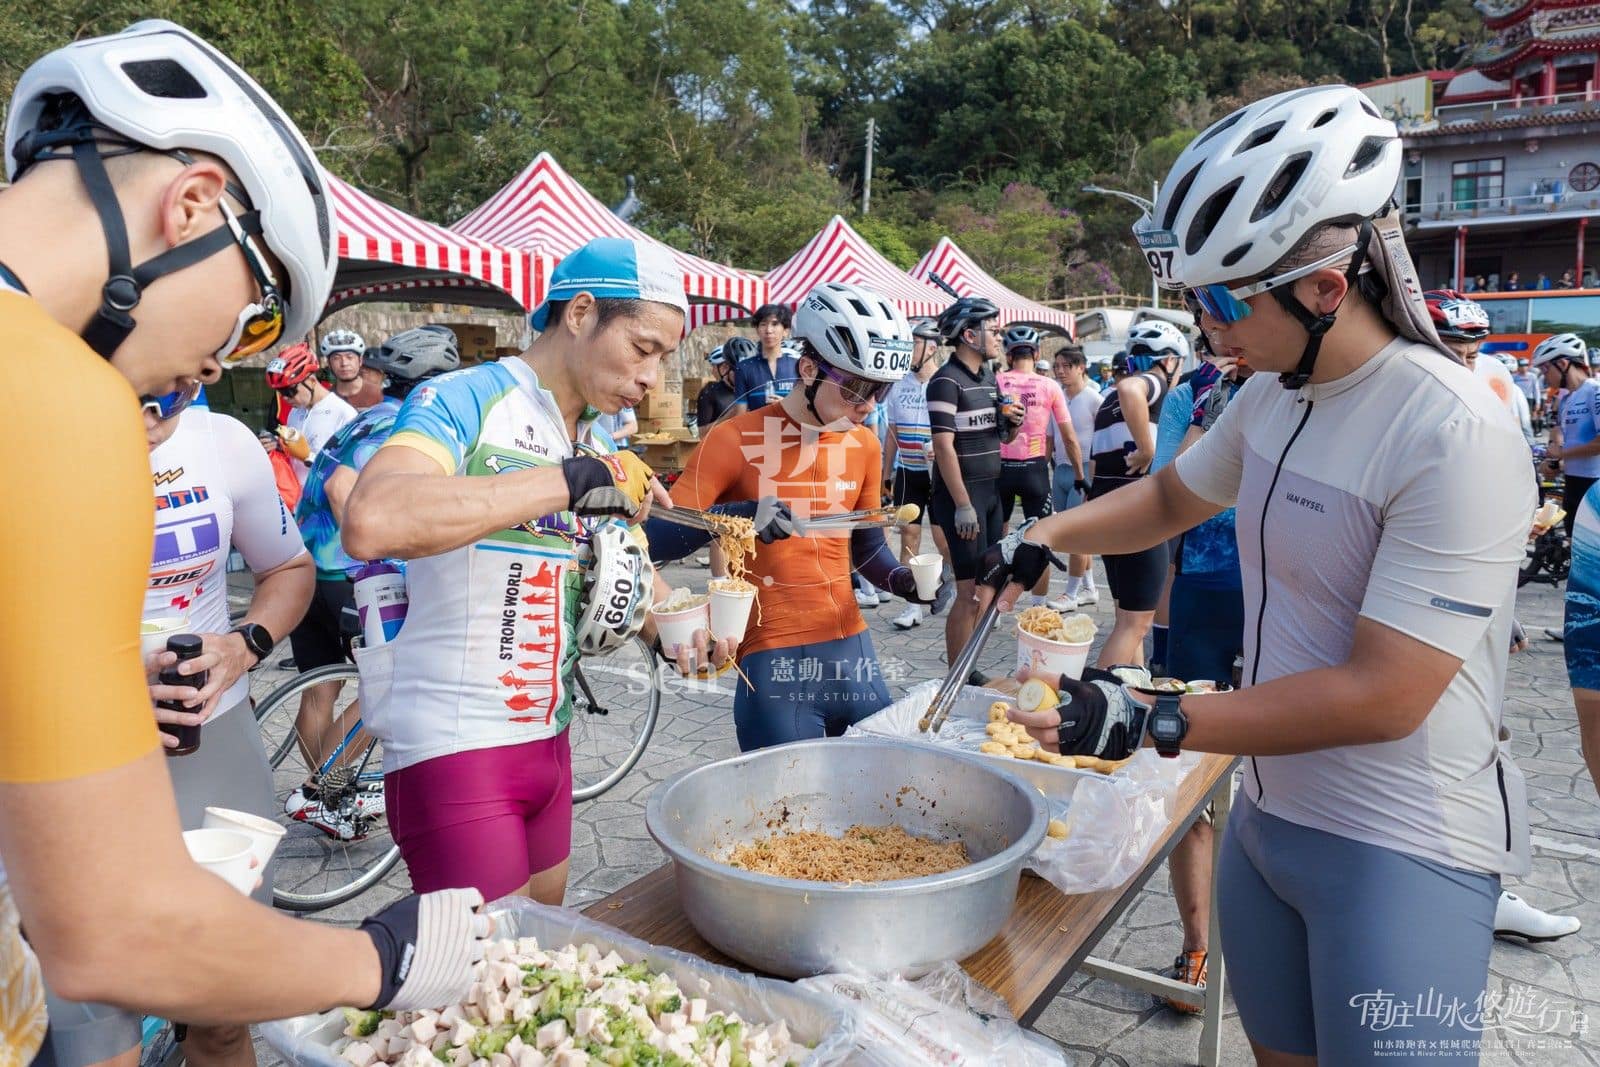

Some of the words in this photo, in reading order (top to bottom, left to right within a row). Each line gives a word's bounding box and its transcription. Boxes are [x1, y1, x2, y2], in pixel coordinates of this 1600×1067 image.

[1147, 250, 1174, 279] 97
[514, 438, 549, 457] PALADIN
[1286, 491, 1300, 504] VAN
[1300, 496, 1326, 513] RYSEL
[152, 568, 203, 586] TIDE
[507, 562, 523, 607] WORLD
[499, 608, 517, 661] STRONG
